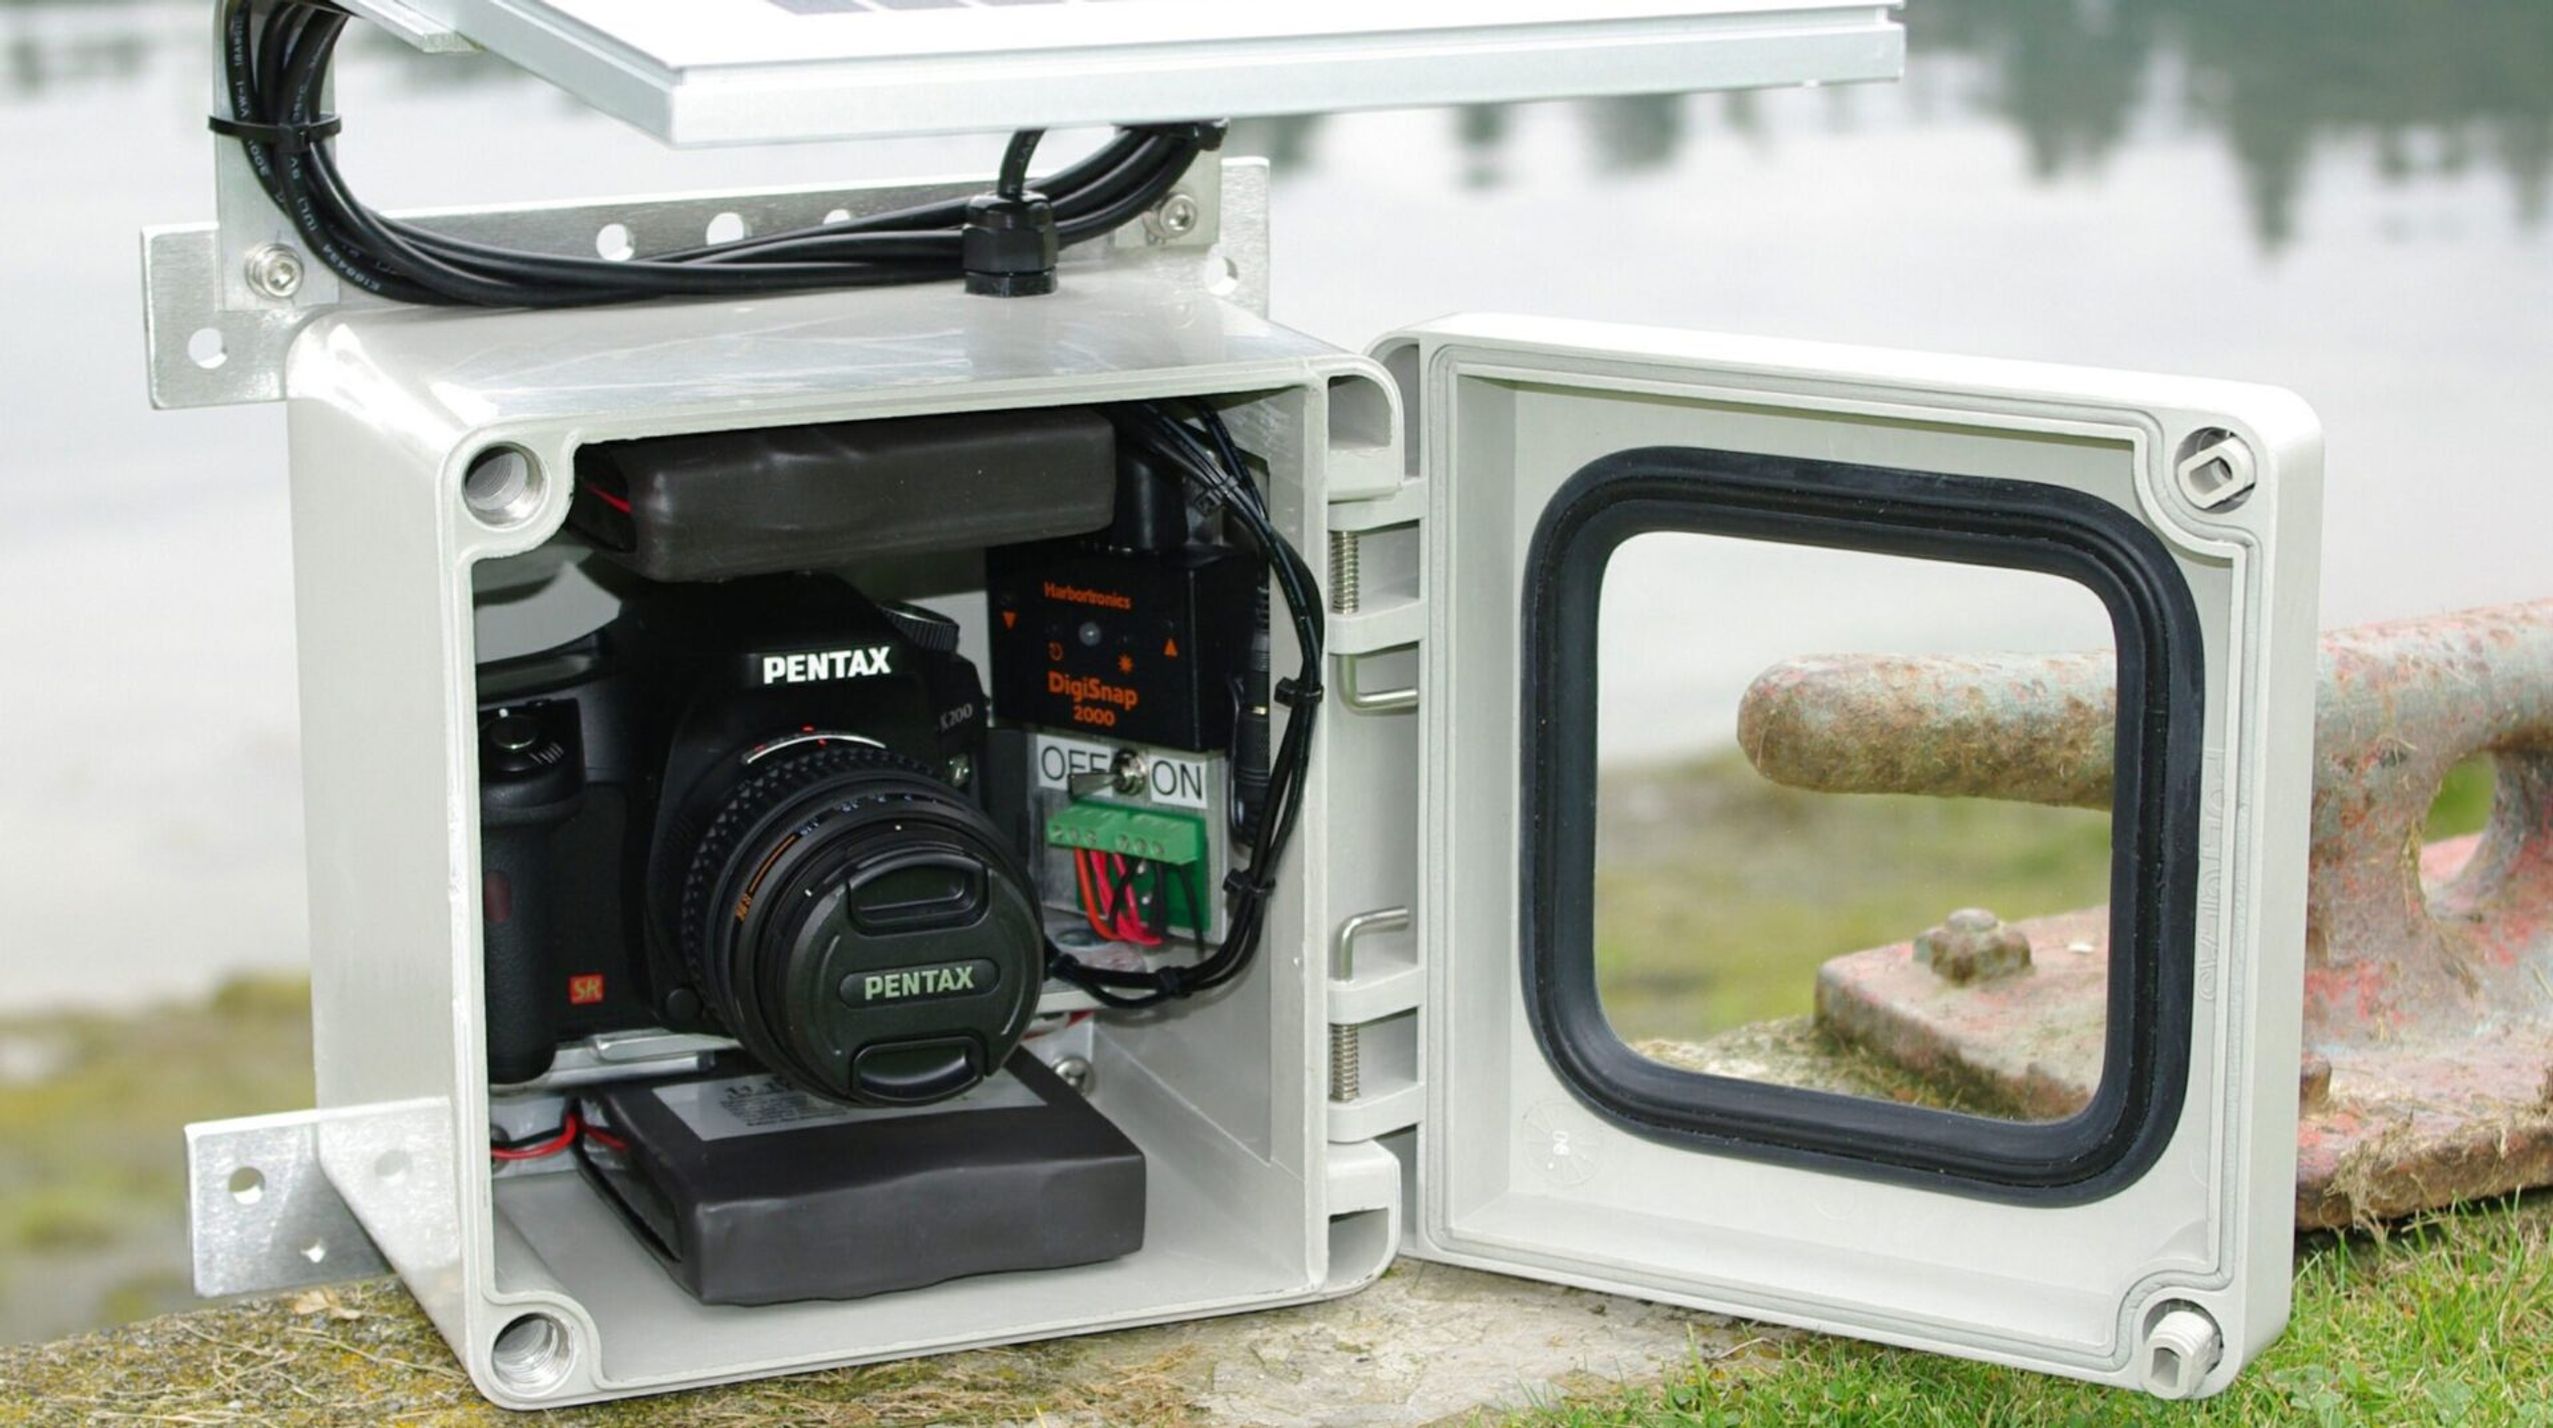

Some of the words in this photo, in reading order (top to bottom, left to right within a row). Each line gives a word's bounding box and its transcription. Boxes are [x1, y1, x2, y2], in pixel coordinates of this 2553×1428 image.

[1043, 581, 1132, 610] Harbortronics
[763, 646, 892, 685] PENTAX
[1048, 670, 1139, 710] DigiSnap
[1073, 706, 1116, 727] 2000
[1152, 760, 1203, 801] ON
[574, 978, 603, 1000] SR
[864, 966, 975, 1001] PENTAX
